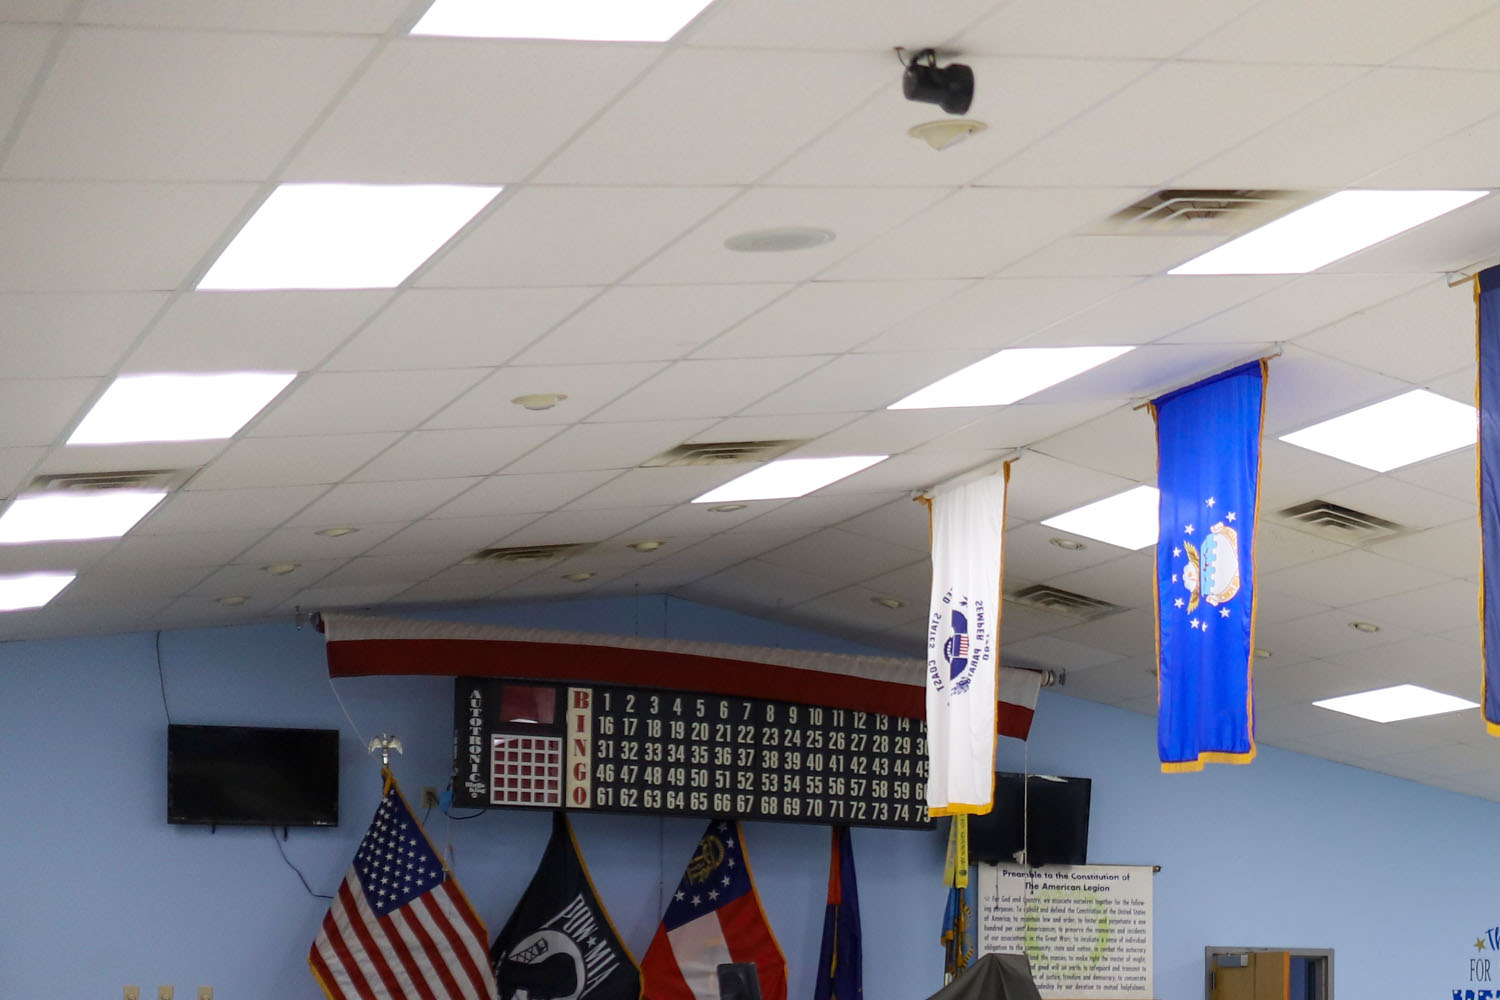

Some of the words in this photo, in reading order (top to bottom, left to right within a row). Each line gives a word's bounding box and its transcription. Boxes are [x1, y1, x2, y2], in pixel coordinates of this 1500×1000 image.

[604, 693, 610, 711] 1
[626, 695, 635, 712] 2
[650, 696, 658, 714] 3
[673, 698, 682, 715] 4
[696, 699, 704, 717] 5
[720, 701, 728, 719] 6
[743, 703, 751, 720] 7
[766, 705, 774, 722] 8
[789, 706, 797, 724] 9
[809, 708, 822, 726] 10
[833, 710, 843, 727] 11
[853, 712, 866, 729] 12
[876, 715, 888, 730] 13
[898, 718, 910, 732] 14
[469, 690, 482, 782] AUTOTRONIC
[572, 690, 590, 806] BINGO
[598, 716, 614, 735] 16
[623, 718, 638, 736] 17
[646, 719, 661, 738] 18
[670, 721, 684, 739] 19
[691, 722, 709, 741] 20
[716, 724, 731, 742] 21
[738, 725, 754, 743] 22
[762, 727, 778, 745] 23
[784, 729, 801, 747] 24
[806, 730, 823, 748] 25
[829, 732, 845, 750] 26
[851, 733, 867, 751] 27
[872, 735, 889, 753] 28
[894, 736, 911, 754] 29
[598, 740, 614, 758] 31
[621, 741, 638, 760] 32
[645, 742, 662, 761] 33
[667, 744, 685, 762] 34
[691, 745, 708, 764] 35
[714, 747, 731, 765] 36
[738, 748, 754, 766] 37
[762, 750, 778, 768] 38
[784, 752, 801, 770] 39
[806, 753, 823, 771] 40
[829, 755, 844, 772] 41
[850, 756, 867, 774] 42
[872, 758, 889, 776] 43
[894, 759, 910, 776] 44
[596, 764, 614, 782] 46
[620, 765, 638, 783] 47
[644, 766, 662, 785] 48
[667, 768, 685, 786] 49
[691, 769, 708, 787] 50
[715, 770, 730, 788] 51
[737, 771, 754, 790] 52
[761, 773, 778, 792] 53
[784, 774, 800, 793] 54
[806, 776, 822, 794] 55
[829, 777, 845, 795] 56
[850, 779, 866, 796] 57
[872, 780, 888, 798] 58
[894, 781, 910, 799] 59
[597, 787, 613, 806] 61
[620, 788, 638, 807] 62
[644, 789, 661, 808] 63
[667, 791, 684, 809] 64
[690, 792, 708, 810] 65
[714, 793, 731, 812] 66
[737, 794, 754, 812] 67
[761, 796, 778, 814] 68
[784, 797, 800, 816] 69
[806, 799, 822, 817] 70
[829, 800, 844, 817] 71
[850, 801, 866, 819] 72
[872, 803, 888, 820] 73
[894, 804, 909, 821] 74
[915, 805, 931, 823] 75
[1002, 870, 1042, 879] Preamble
[1056, 872, 1068, 880] the
[1071, 873, 1119, 881] Constitution
[1122, 873, 1130, 881] of
[1025, 882, 1039, 890] The
[1042, 882, 1080, 891] American
[1084, 884, 1110, 893] Legion
[539, 893, 599, 943] POW
[578, 939, 620, 1000] MIA
[1470, 958, 1492, 982] FOR
